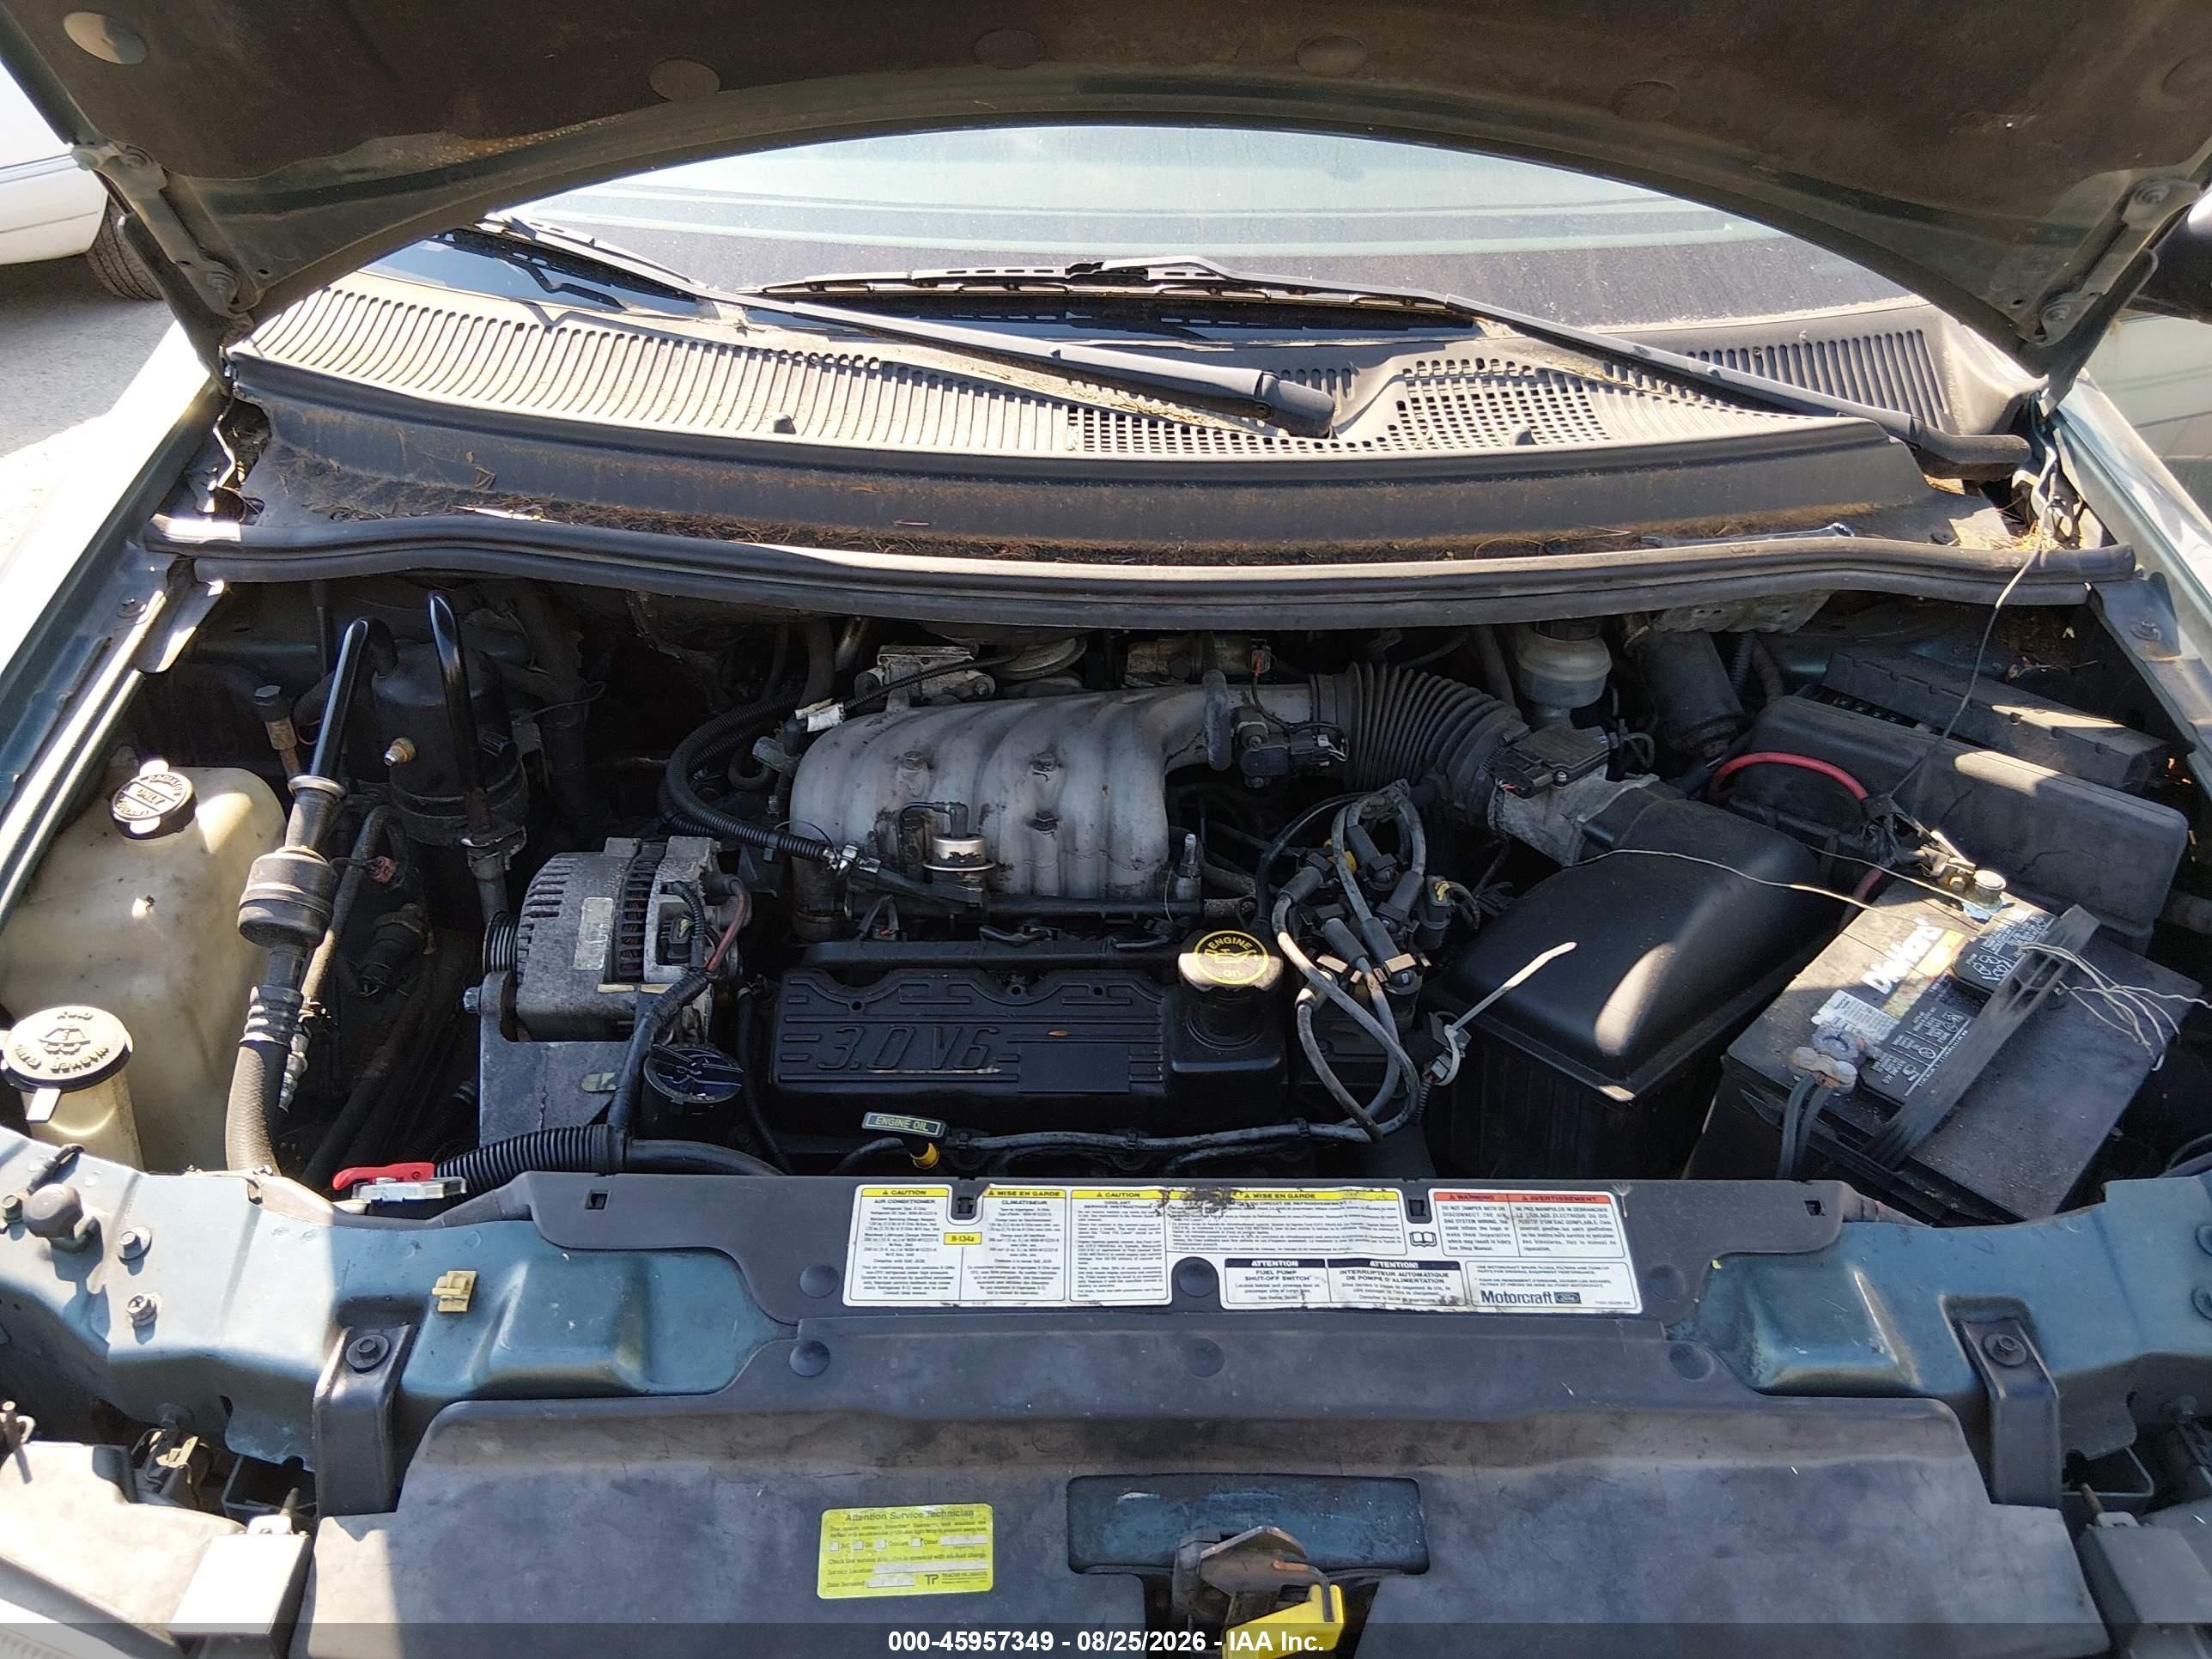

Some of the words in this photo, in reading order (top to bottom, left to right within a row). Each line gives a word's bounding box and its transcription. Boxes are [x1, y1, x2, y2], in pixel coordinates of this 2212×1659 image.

[1206, 936, 1254, 950] ENGINE
[817, 1026, 916, 1071] 3.0
[931, 1026, 1000, 1071] V6
[49, 1046, 110, 1074] WASHER
[874, 1116, 911, 1128] ENGINE
[913, 1121, 929, 1132] OIL
[1480, 1289, 1554, 1304] Motorcraft
[844, 1513, 888, 1522] Attention
[890, 1510, 924, 1520] Service
